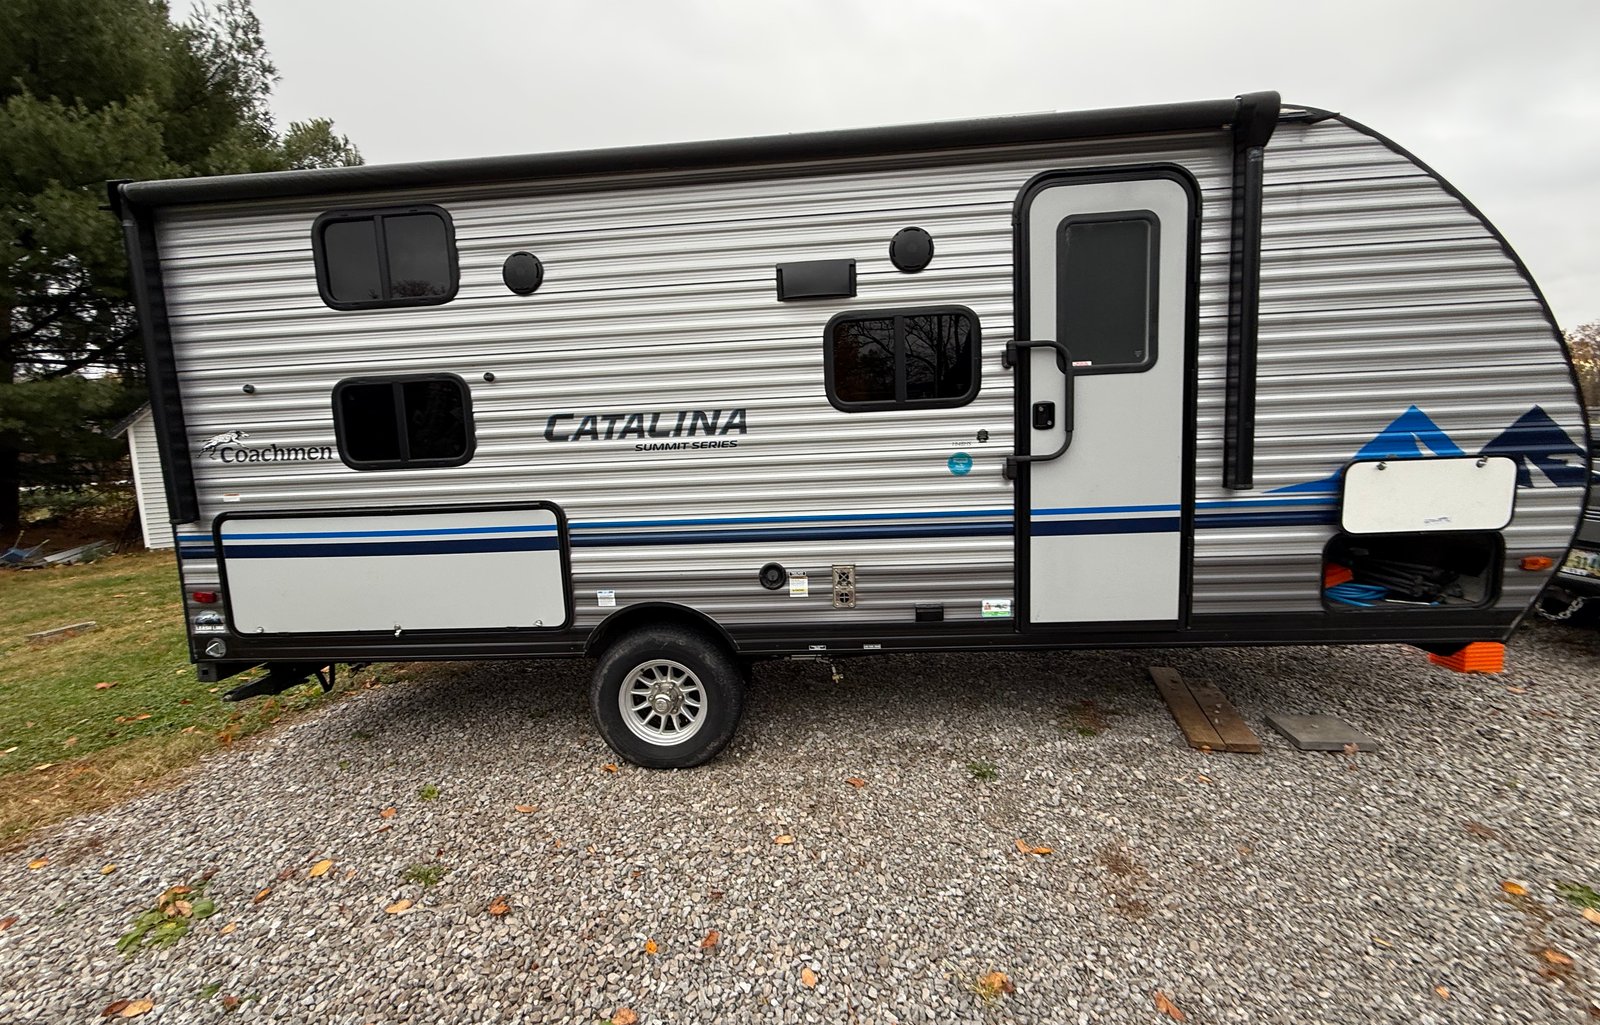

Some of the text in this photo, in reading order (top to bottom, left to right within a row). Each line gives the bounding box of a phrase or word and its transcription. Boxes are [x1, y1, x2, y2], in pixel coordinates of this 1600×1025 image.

[544, 408, 748, 442] CATALINA
[220, 444, 333, 463] Coachmen
[635, 440, 738, 452] SUMMIT SERIES
